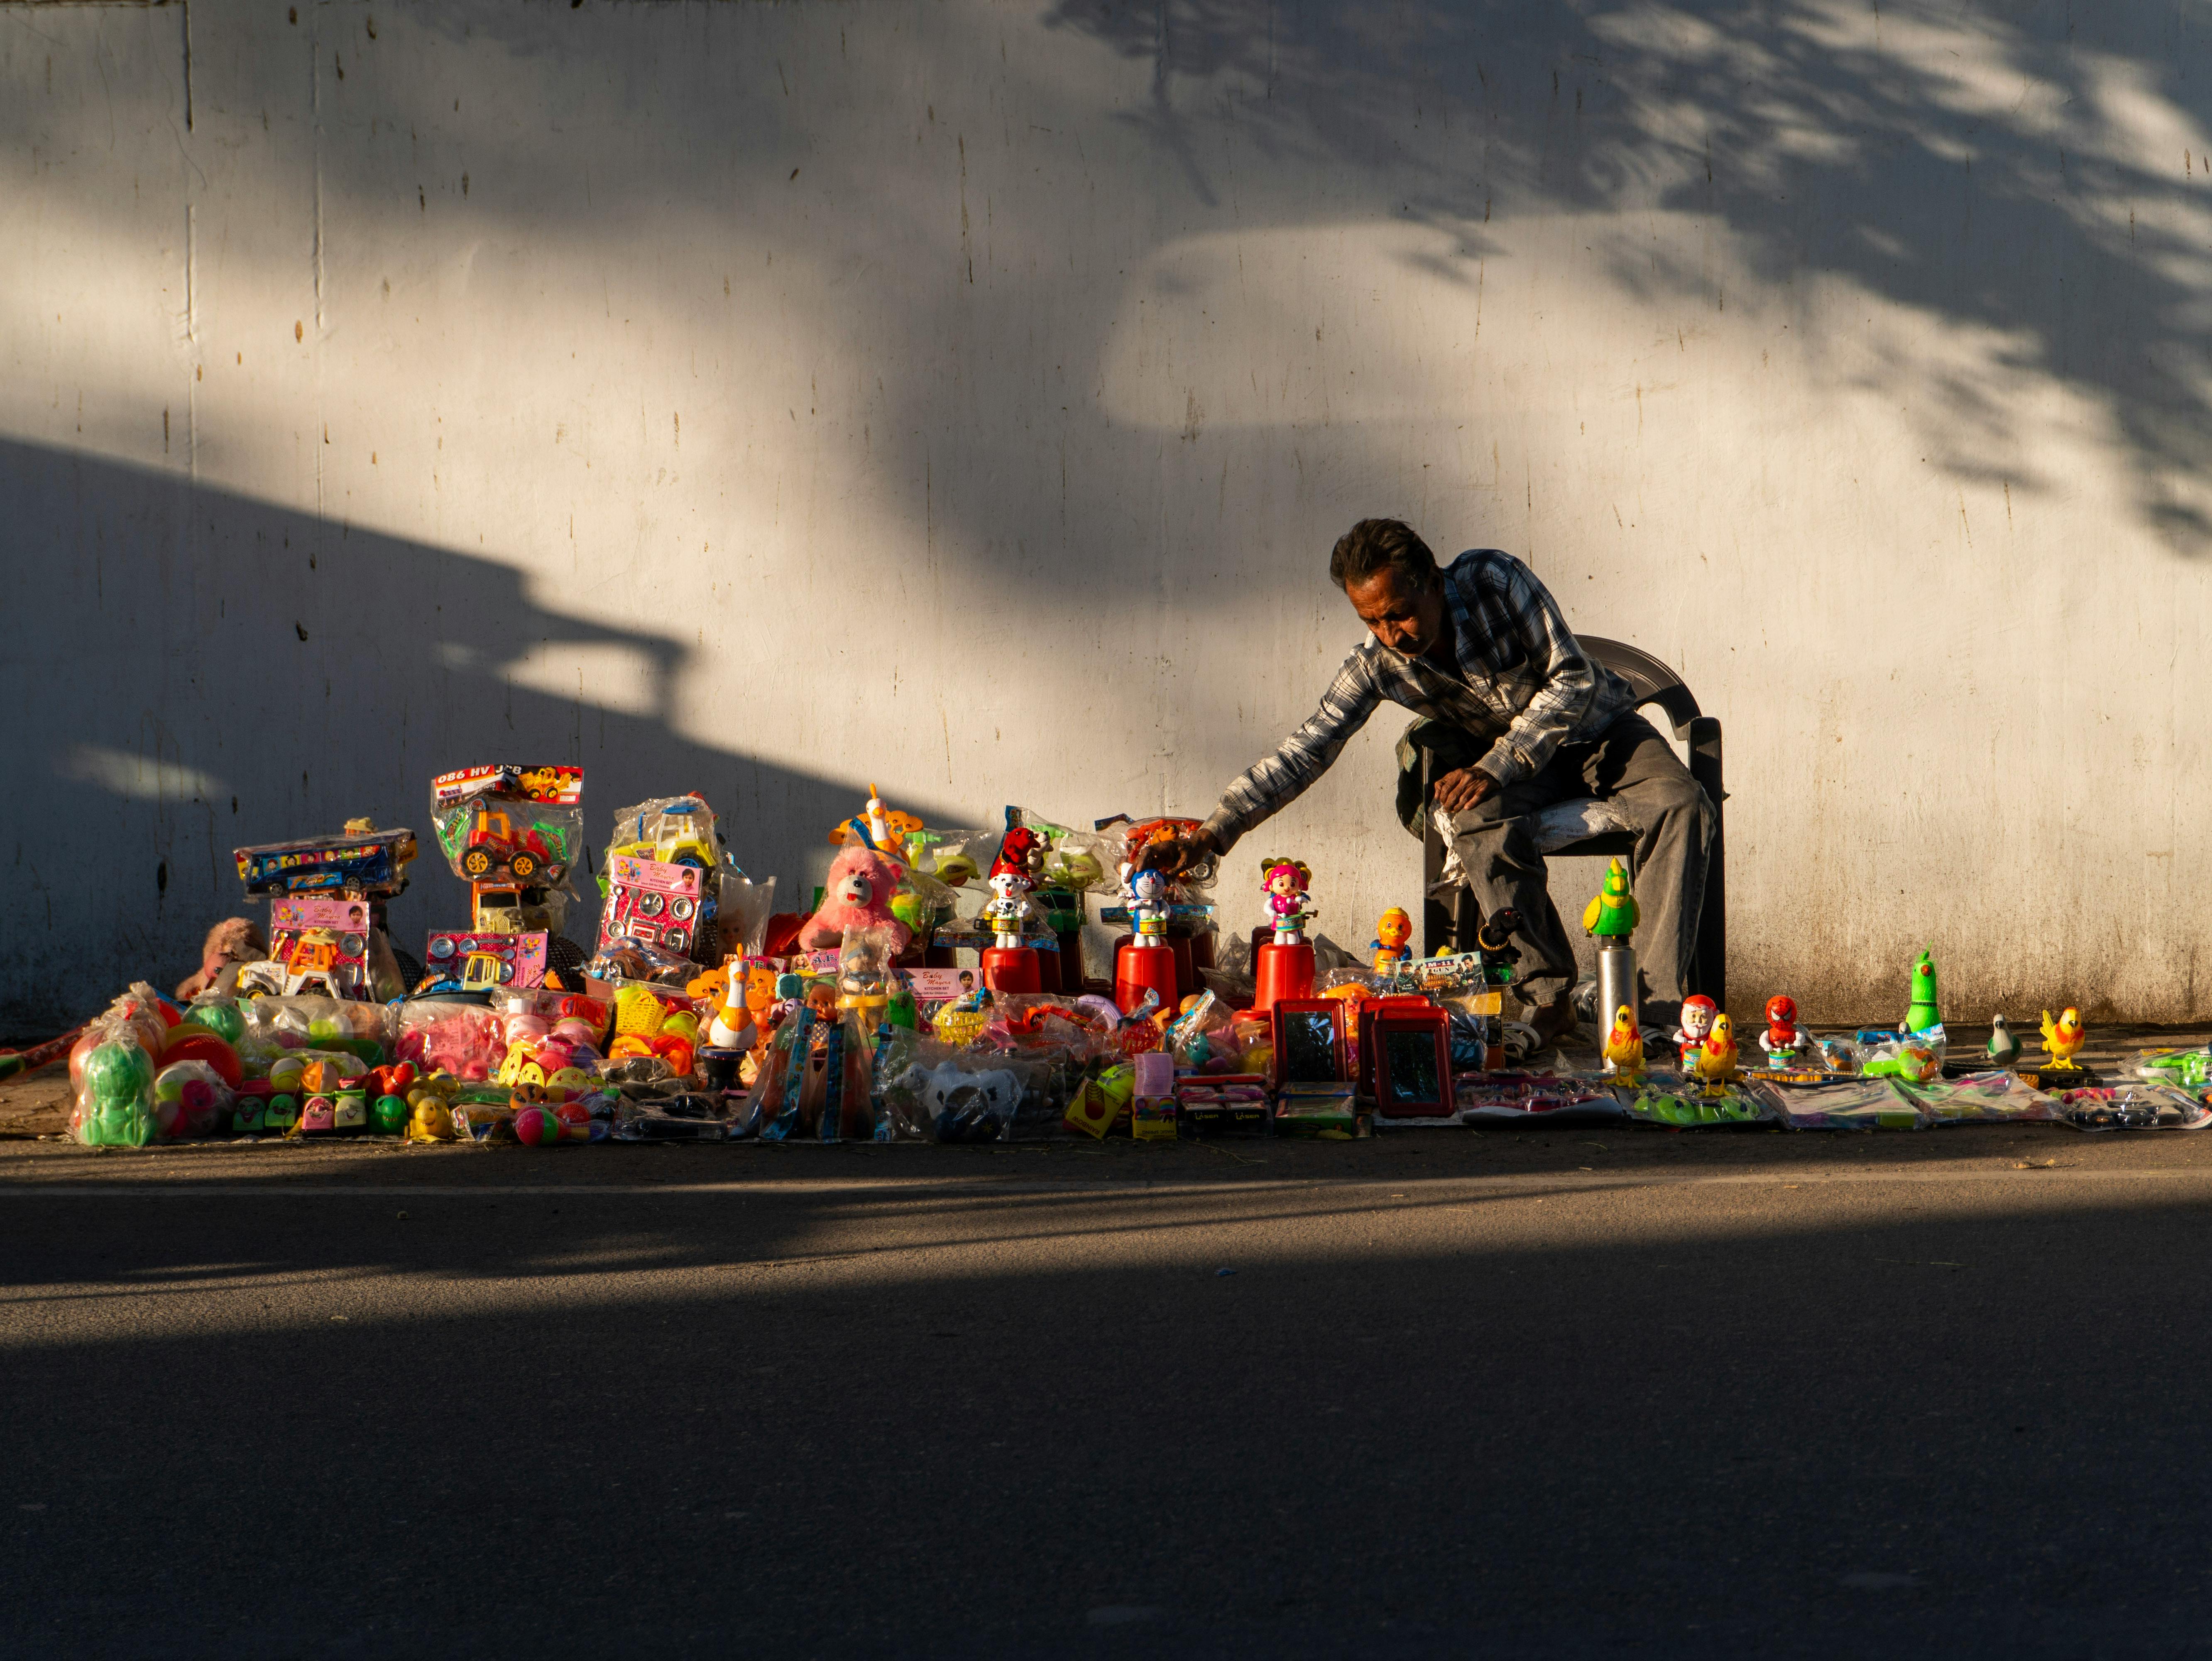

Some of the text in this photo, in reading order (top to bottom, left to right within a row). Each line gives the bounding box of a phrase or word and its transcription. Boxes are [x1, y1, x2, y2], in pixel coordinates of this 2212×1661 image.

[438, 770, 465, 784] 086
[470, 766, 490, 777] HV
[495, 764, 522, 775] JCB
[649, 863, 668, 873] Baby
[313, 905, 333, 914] Baby
[813, 954, 838, 964] A.F.
[531, 964, 540, 979] Baby
[922, 971, 942, 980] Baby
[1195, 1112, 1219, 1120] LASER
[1235, 1112, 1260, 1120] LASER
[1072, 1116, 1100, 1135] RAINBOW
